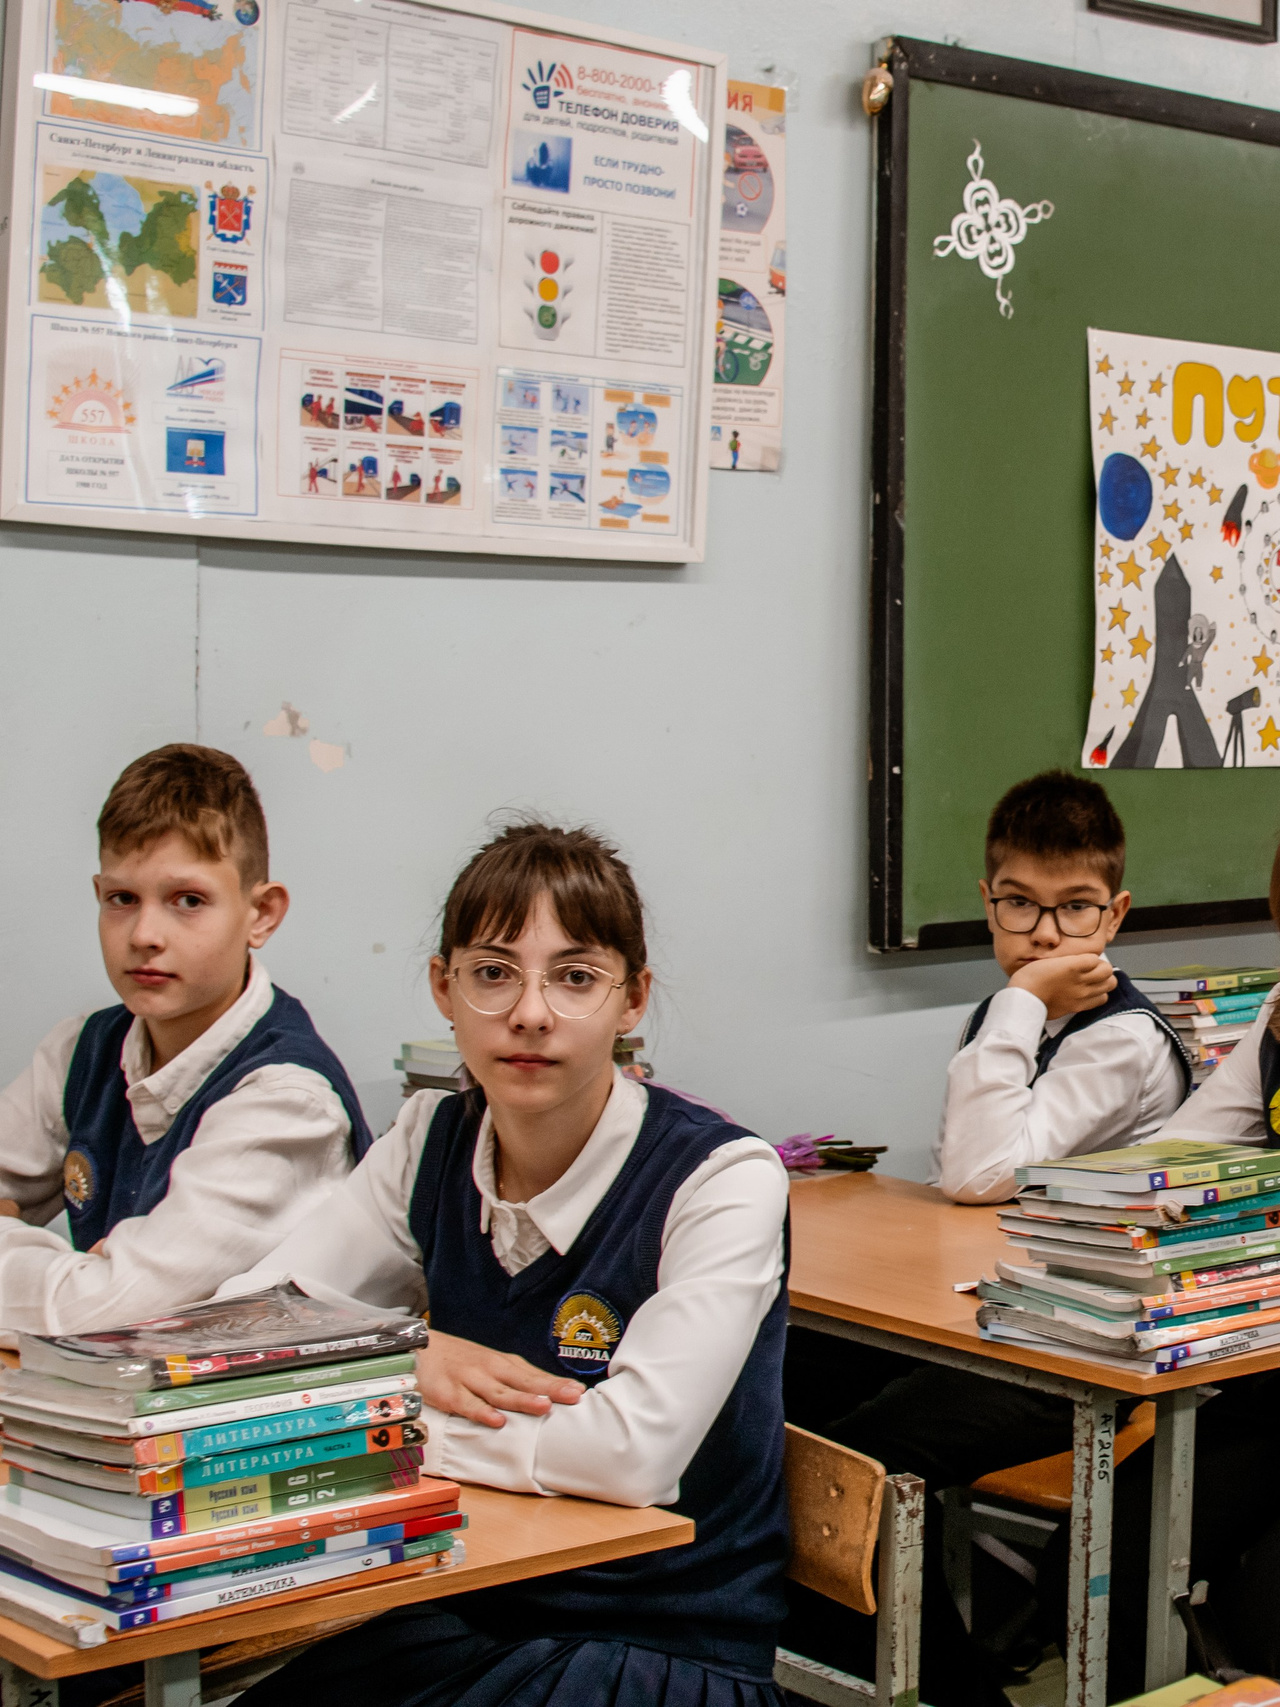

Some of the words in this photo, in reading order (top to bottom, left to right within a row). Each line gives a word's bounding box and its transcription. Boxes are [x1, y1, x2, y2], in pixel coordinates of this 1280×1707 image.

[558, 101, 618, 121] ТЕЛЕФОН
[620, 112, 679, 132] ДОВЕРИЯ
[49, 132, 132, 156] Санкт-Петербург
[144, 147, 215, 168] Ленинградская
[217, 159, 254, 173] область
[593, 155, 619, 168] ЕСЛИ
[583, 176, 623, 192] ПРОСТО
[625, 183, 676, 199] ПОЗВОНИ!
[80, 408, 105, 423] 557
[557, 1345, 611, 1362] ШКОЛА
[203, 1416, 317, 1448] ЛИТЕРАТУРА
[201, 1445, 315, 1478] ЛИТЕРАТУРА
[372, 1429, 391, 1449] 6
[209, 1483, 237, 1502] Русский
[240, 1483, 258, 1496] язык
[211, 1503, 239, 1522] Русский
[242, 1503, 259, 1516] язык
[215, 1528, 246, 1543] История
[248, 1523, 273, 1537] России
[333, 1510, 354, 1520] Часть
[219, 1542, 250, 1556] История
[251, 1538, 277, 1552] России
[217, 1576, 297, 1604] МАТЕМАТИКА
